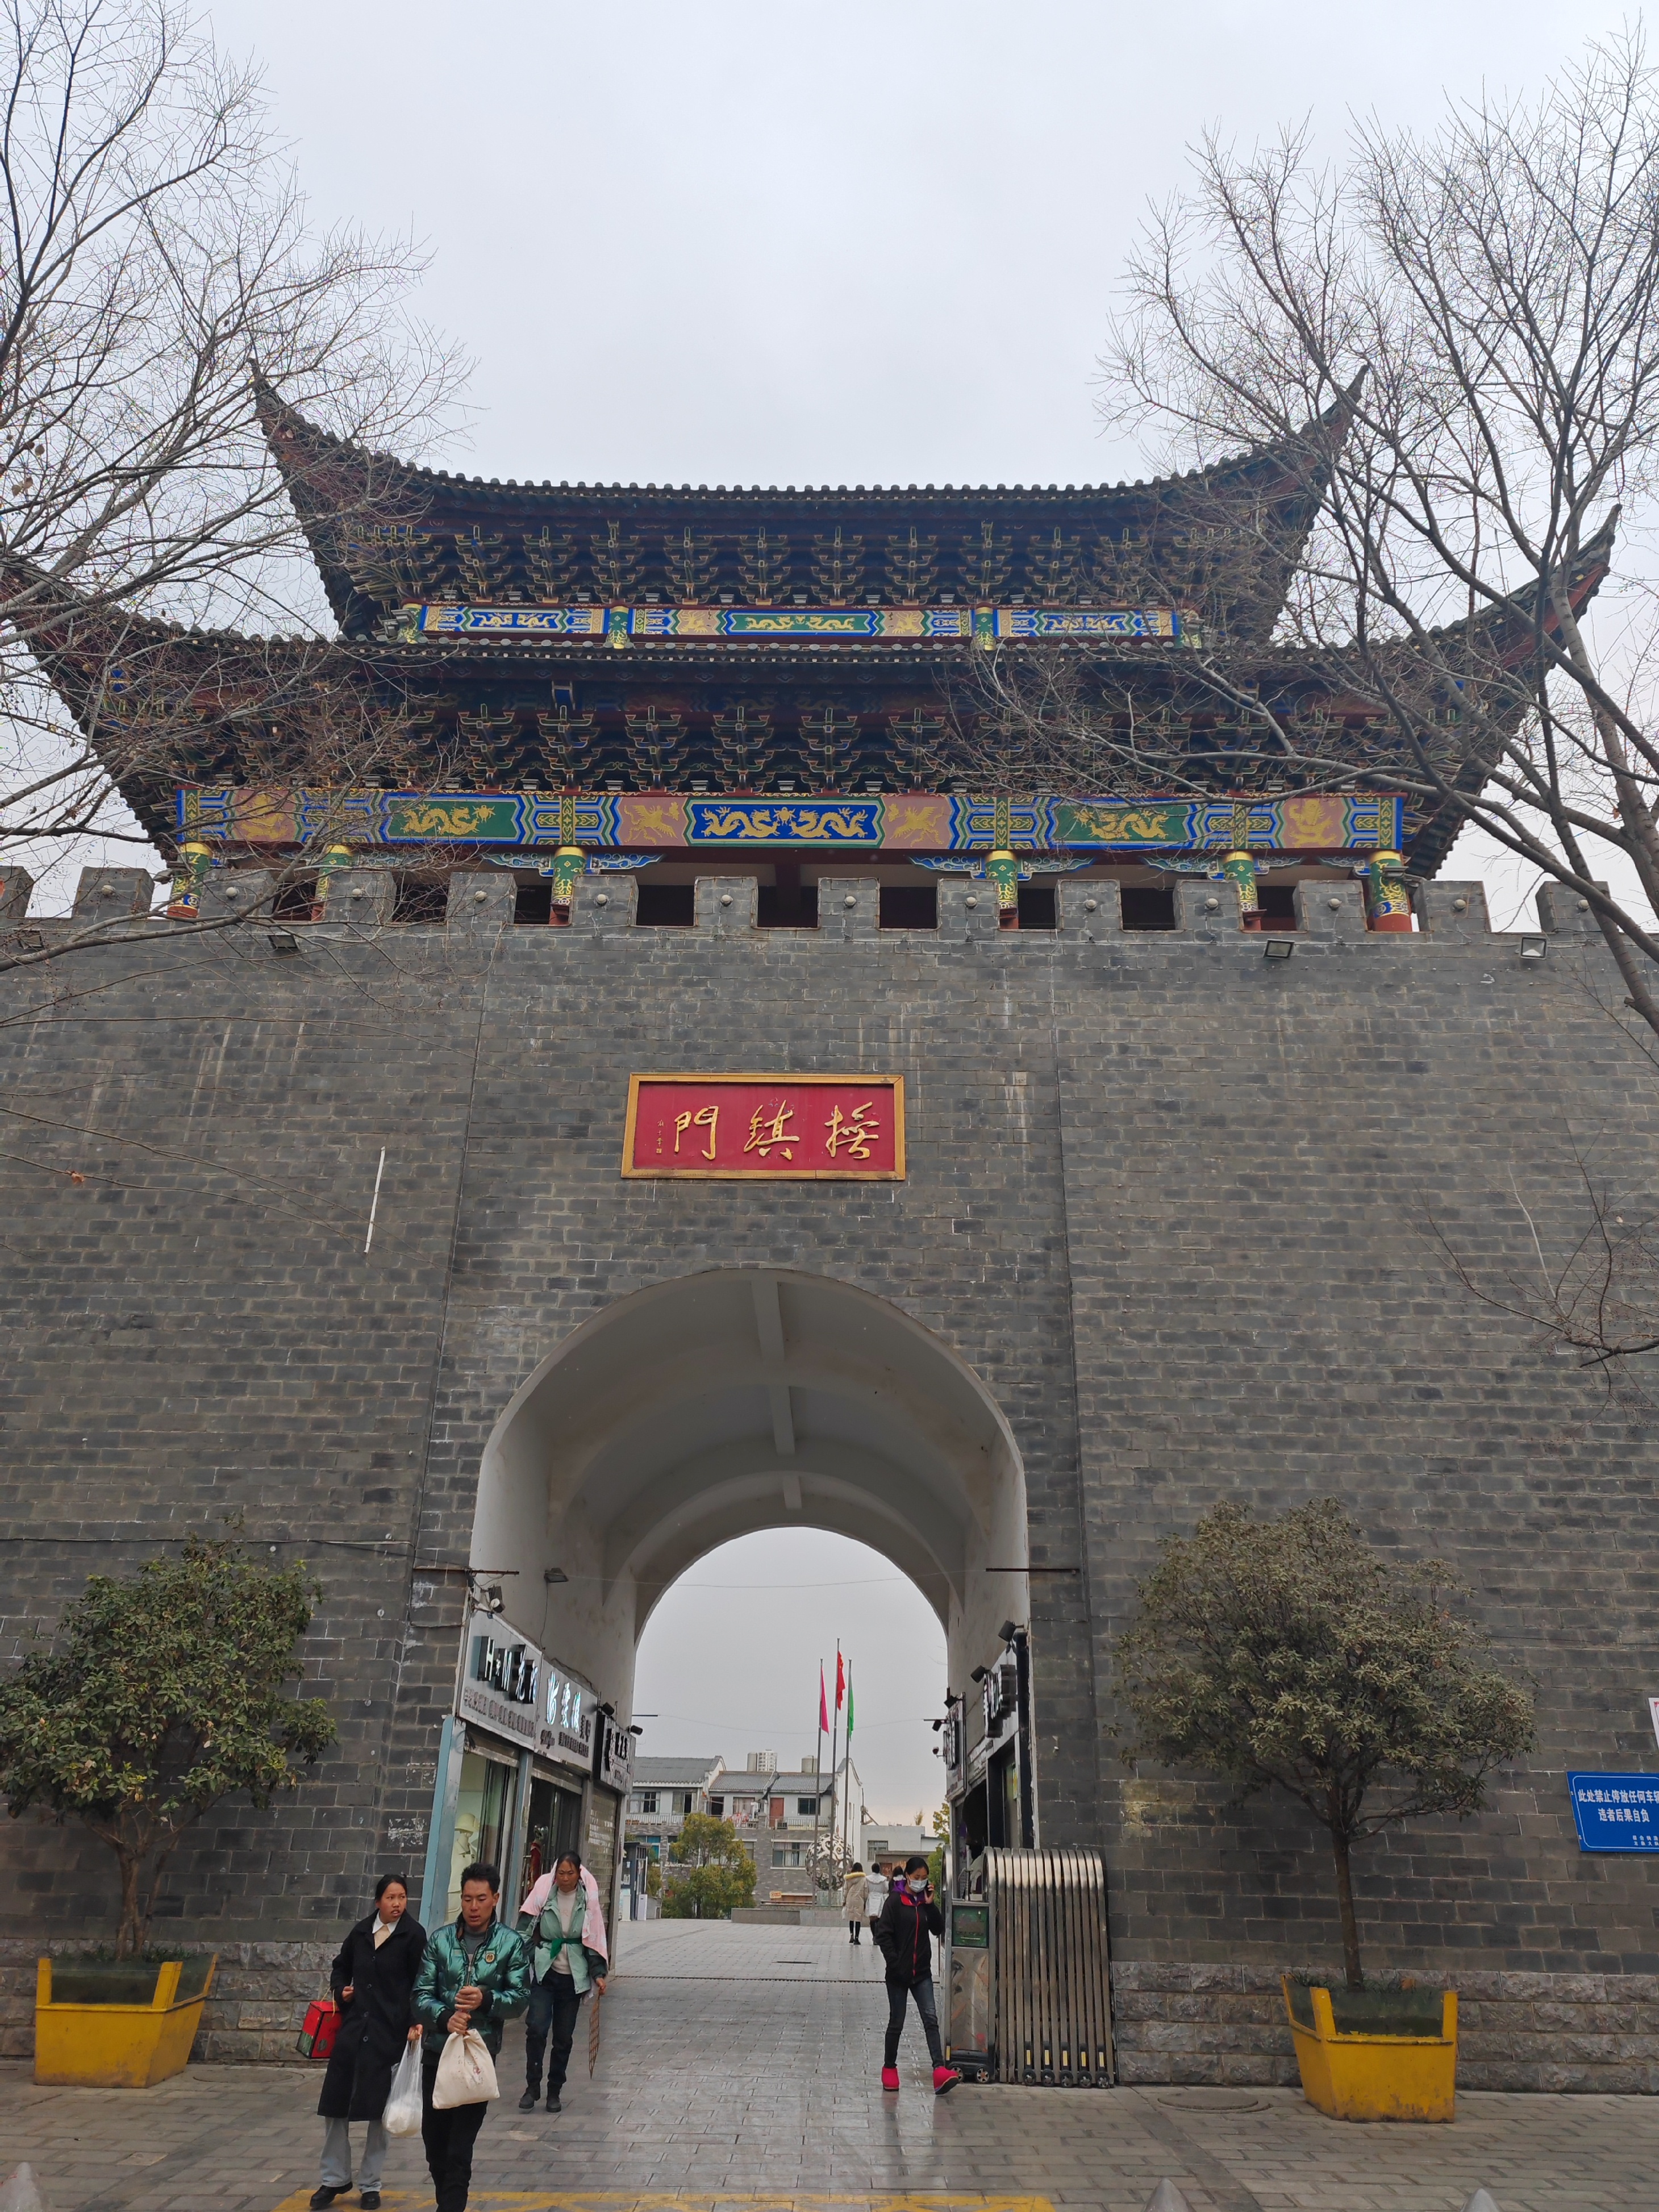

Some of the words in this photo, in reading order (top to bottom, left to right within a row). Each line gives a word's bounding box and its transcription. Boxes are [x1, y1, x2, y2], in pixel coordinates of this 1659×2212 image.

[1598, 1808, 1650, 1822] 违者后果自负
